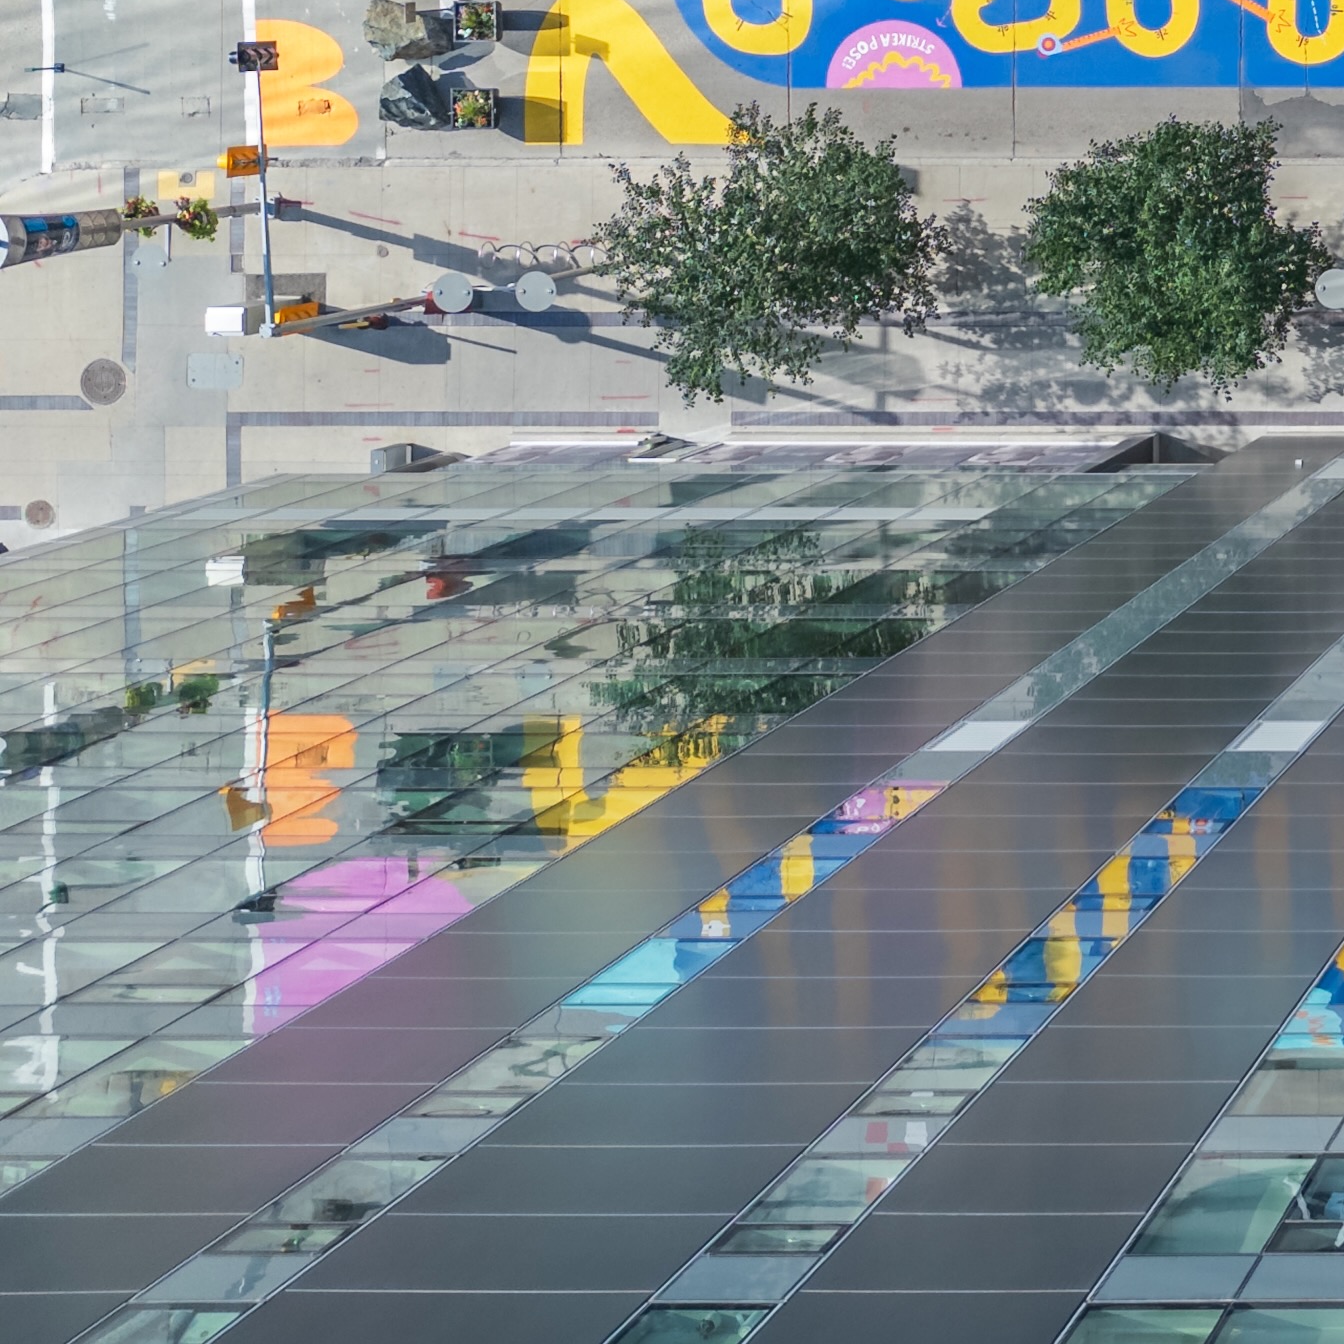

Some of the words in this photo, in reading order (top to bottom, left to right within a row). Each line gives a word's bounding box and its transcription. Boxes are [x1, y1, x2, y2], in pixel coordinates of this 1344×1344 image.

[879, 33, 890, 47] A
[892, 32, 935, 55] STRIKE
[841, 35, 879, 71] POSE!
